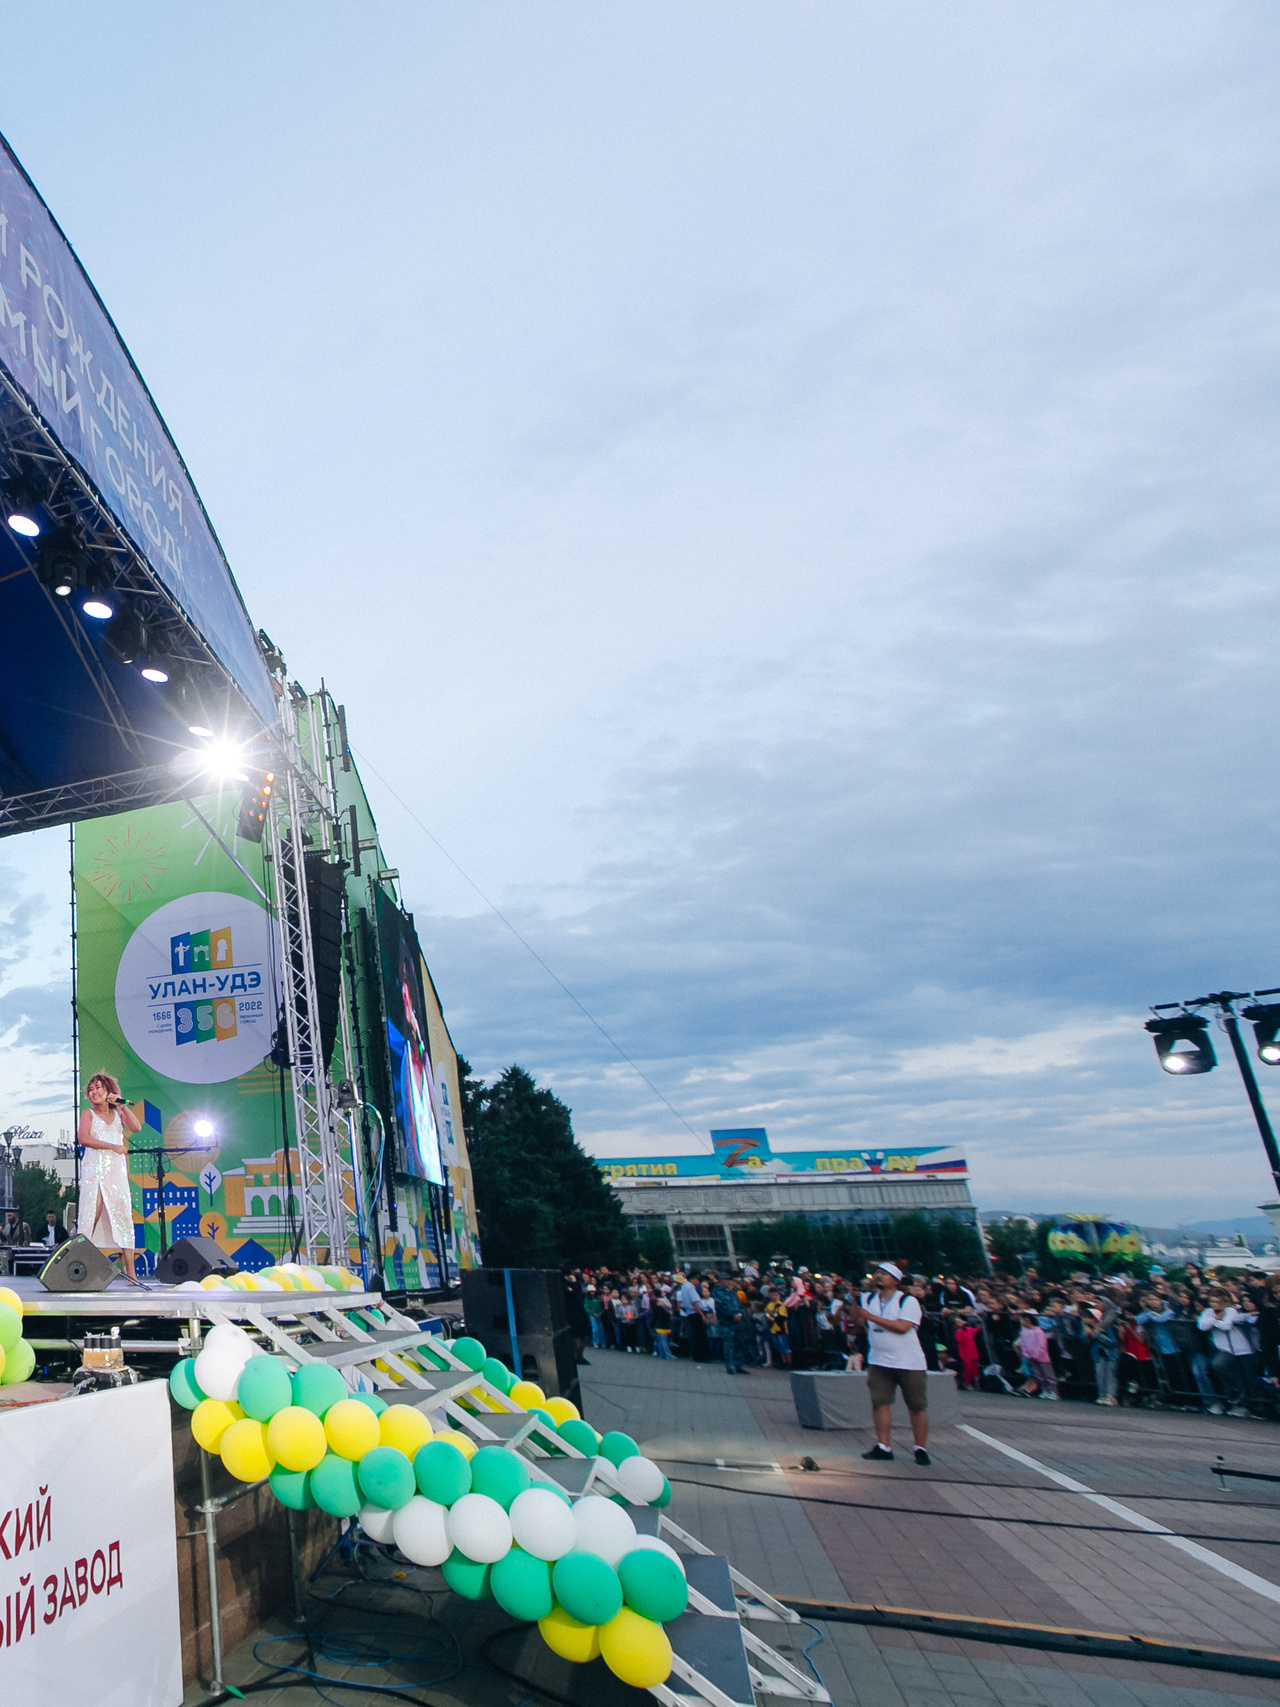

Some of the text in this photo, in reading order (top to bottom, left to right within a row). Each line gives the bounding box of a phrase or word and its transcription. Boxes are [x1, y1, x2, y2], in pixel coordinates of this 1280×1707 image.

[148, 971, 261, 1000] УЛАН-УДЭ
[152, 1010, 172, 1021] 1666
[176, 1002, 235, 1034] 356
[238, 1000, 263, 1012] 2022
[598, 1163, 678, 1182] рятия
[42, 1540, 123, 1625] ЗАВОД
